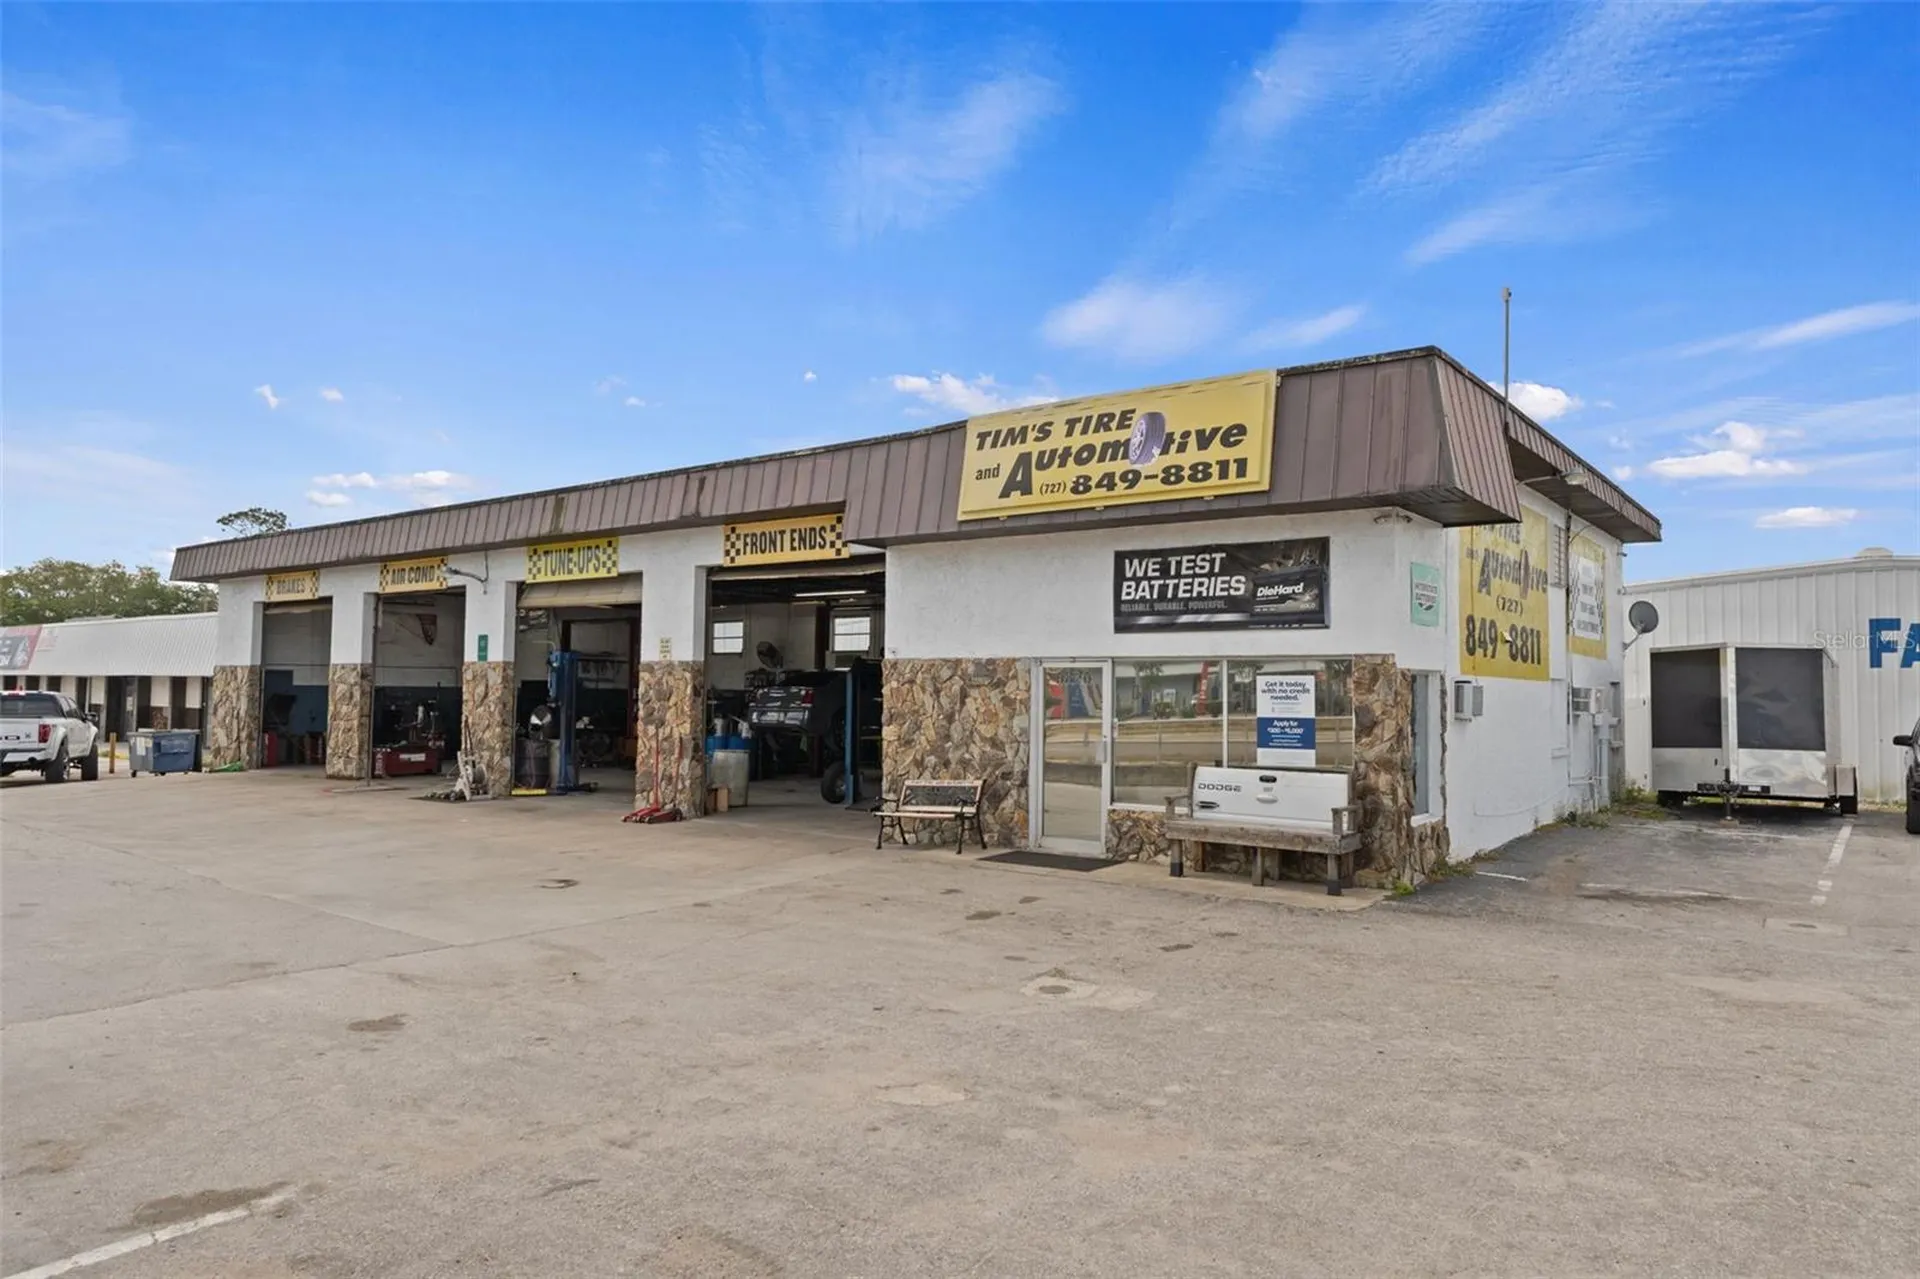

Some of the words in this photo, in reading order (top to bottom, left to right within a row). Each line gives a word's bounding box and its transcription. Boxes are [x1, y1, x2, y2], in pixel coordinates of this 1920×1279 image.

[976, 421, 1054, 451] TIM'S
[1065, 408, 1137, 438] TIRE
[975, 463, 1001, 481] and
[1039, 480, 1067, 496] (727)
[1070, 457, 1248, 495] 849-8811
[743, 530, 787, 555] FRONT
[790, 525, 827, 552] ENDS
[542, 544, 601, 577] TUNE-UPS
[1125, 557, 1162, 578] WE
[1168, 552, 1227, 577] TEST
[390, 567, 406, 585] AIR
[408, 565, 436, 584] COND
[276, 577, 306, 595] BRAKES
[1121, 575, 1247, 601] BATTERIES
[1256, 582, 1304, 598] DieHard
[1496, 595, 1524, 618] (727)
[1279, 680, 1284, 688] it
[1285, 680, 1307, 689] today
[1289, 688, 1311, 696] credit
[1198, 783, 1242, 793] DODGE
